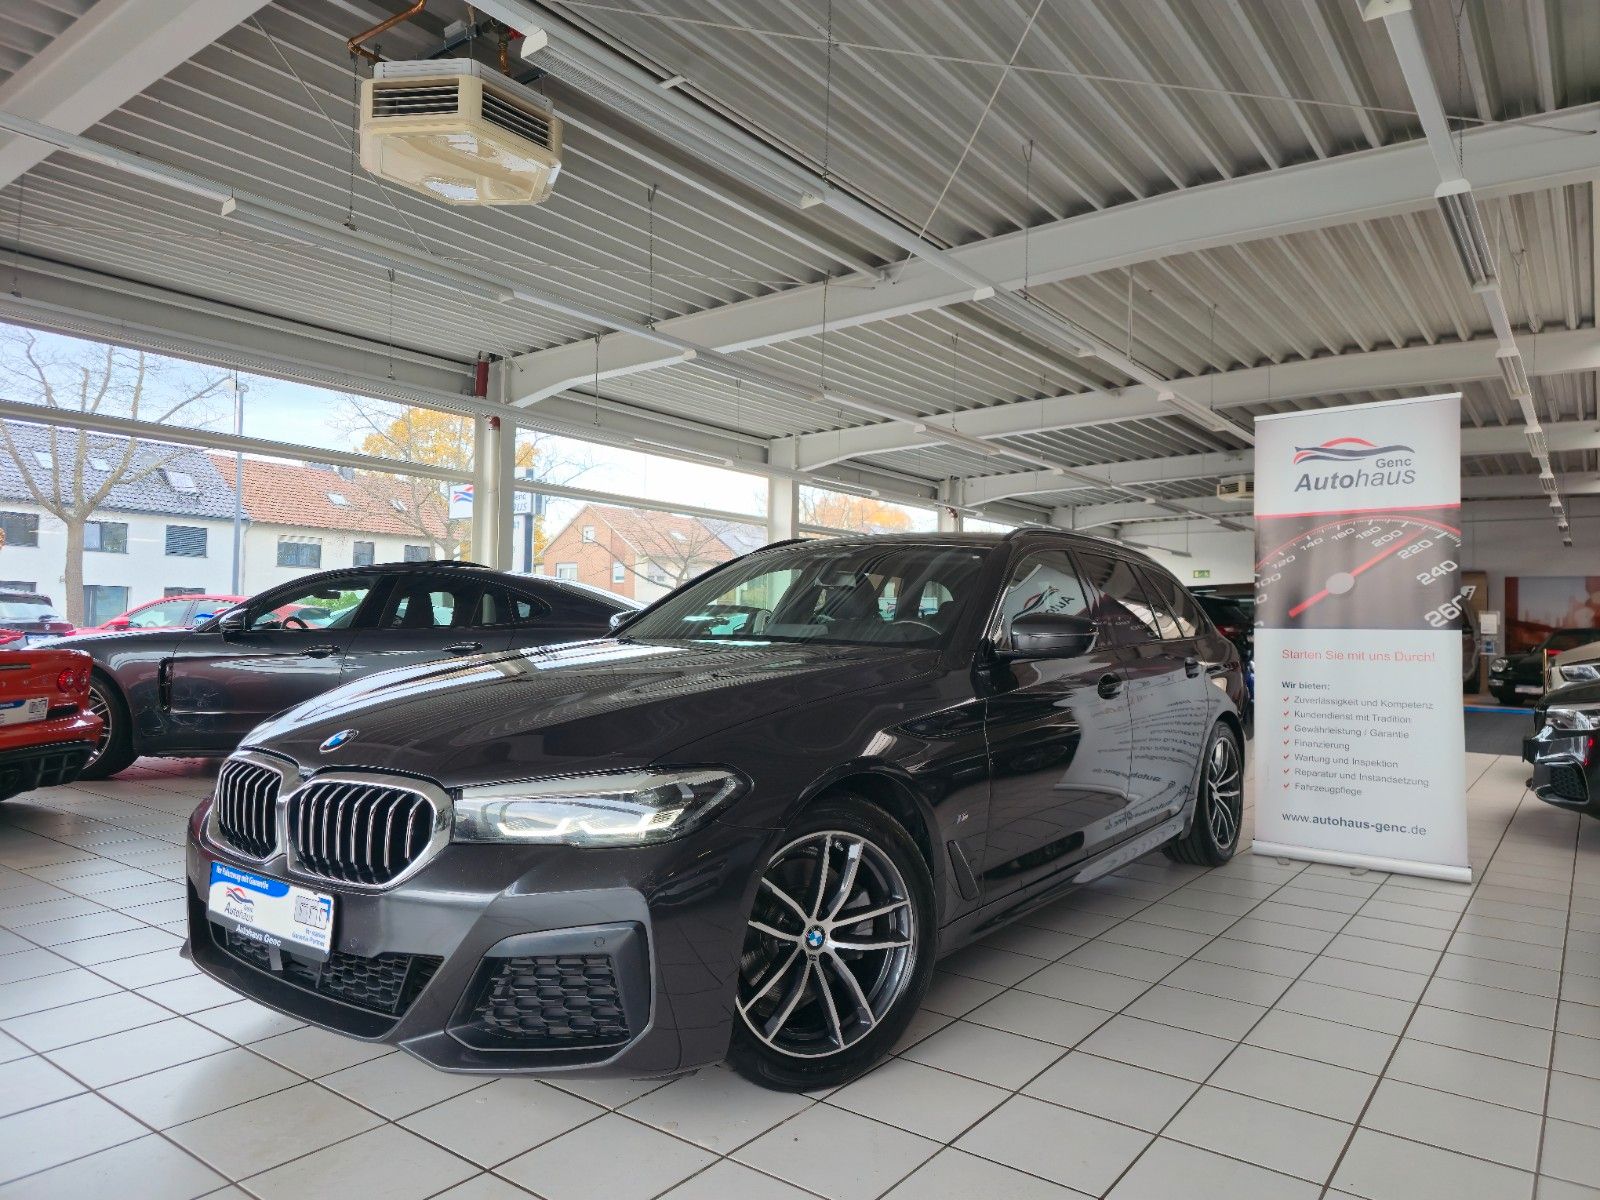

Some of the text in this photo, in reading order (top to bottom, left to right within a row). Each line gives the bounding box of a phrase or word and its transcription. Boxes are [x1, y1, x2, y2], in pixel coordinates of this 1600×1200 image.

[1375, 458, 1412, 469] Genc
[1295, 469, 1416, 492] Autohaus
[1371, 530, 1403, 547] 200
[1397, 539, 1433, 559] 220
[1254, 573, 1281, 589] 100
[1416, 560, 1458, 586] 240
[1282, 649, 1436, 663] Starten Sie mit uns Durch!
[1281, 681, 1331, 691] Wir bieten:
[1293, 695, 1434, 710] Zuverlässigkeit und Kompetenz
[1294, 710, 1354, 721] Kundendienst
[1372, 713, 1412, 724] Tradition
[1294, 725, 1362, 738] Gewährleistung
[1369, 728, 1410, 739] Garantie
[1294, 738, 1350, 751] Finanzierung
[1294, 753, 1399, 769] Wartung und Inspektion
[1294, 768, 1430, 788] Reparatur und Instandsetzung
[1294, 783, 1363, 797] Fahrzeugpflege
[1281, 811, 1428, 836] www.autohaus-genc.de
[225, 902, 254, 922] Autohaus
[235, 923, 263, 941] Autohaus
[264, 934, 281, 947] Genc
